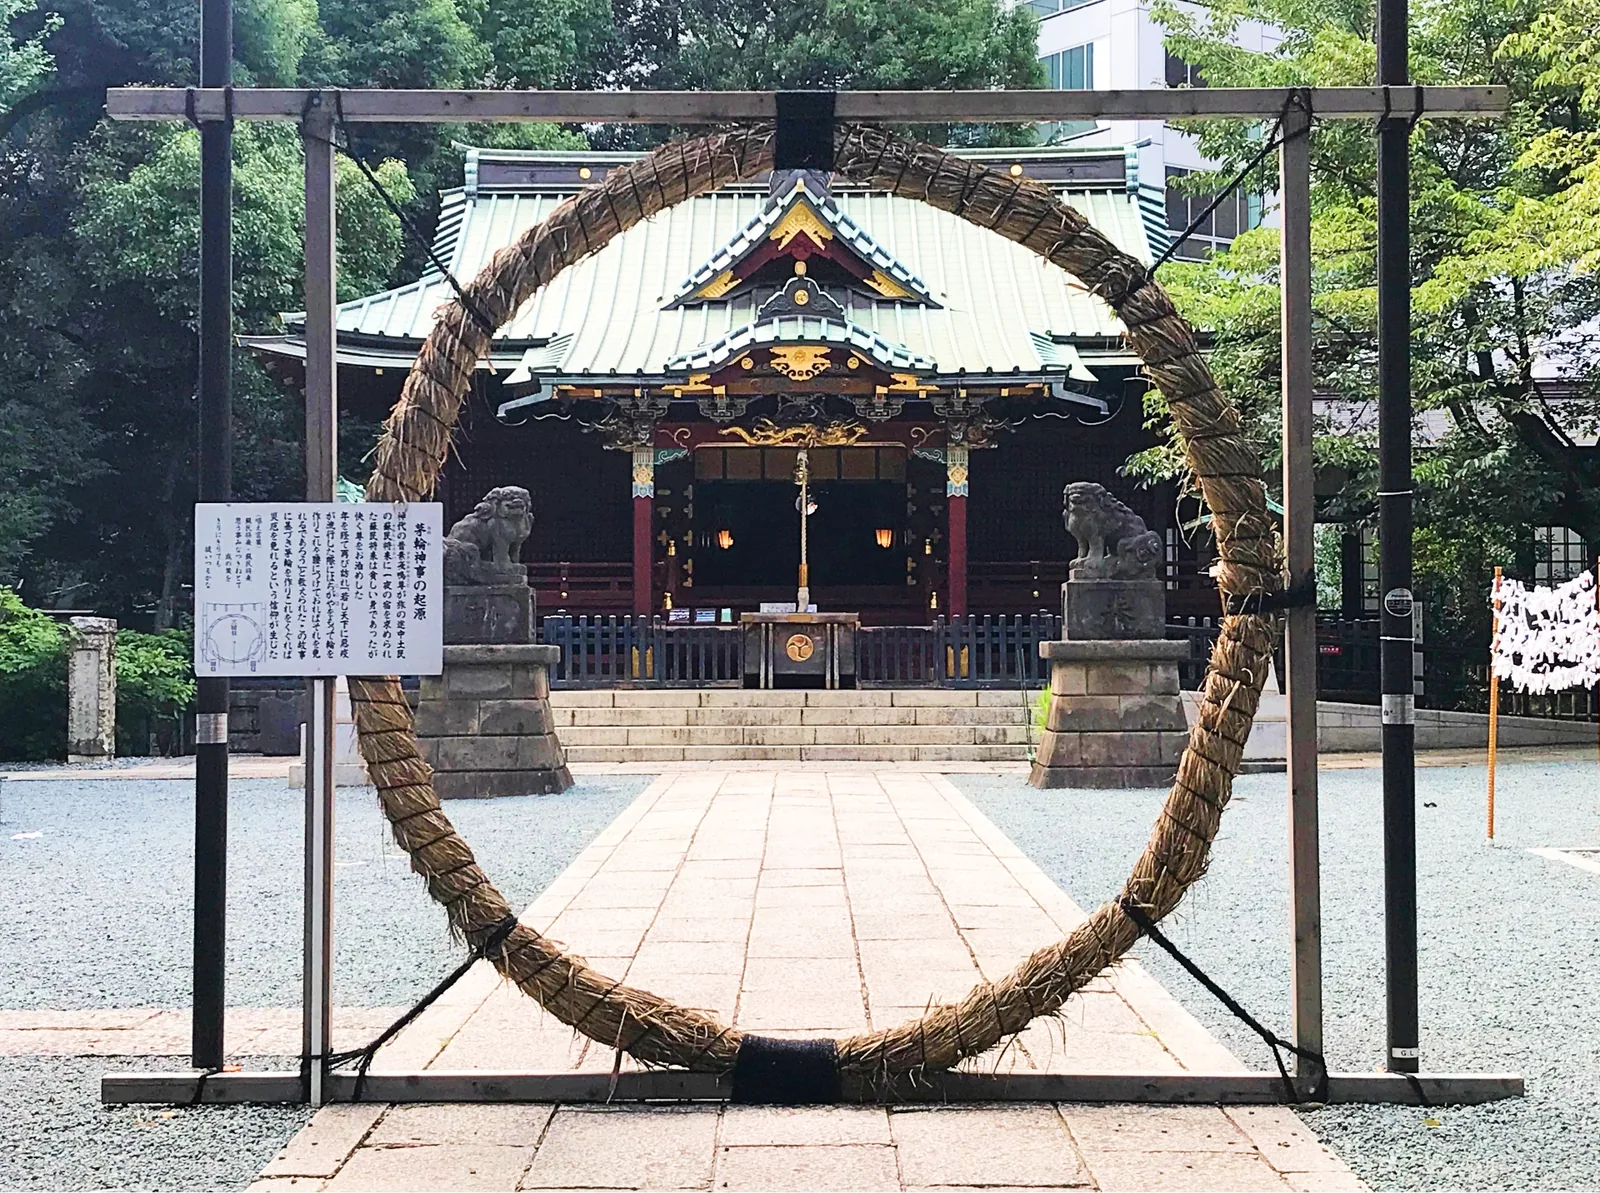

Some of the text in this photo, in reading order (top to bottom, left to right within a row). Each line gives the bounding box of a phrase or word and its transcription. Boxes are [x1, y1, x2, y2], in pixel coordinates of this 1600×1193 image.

[354, 512, 364, 600] 快く尊をお泊めした
[413, 522, 427, 620] 茅輪神事の起源
